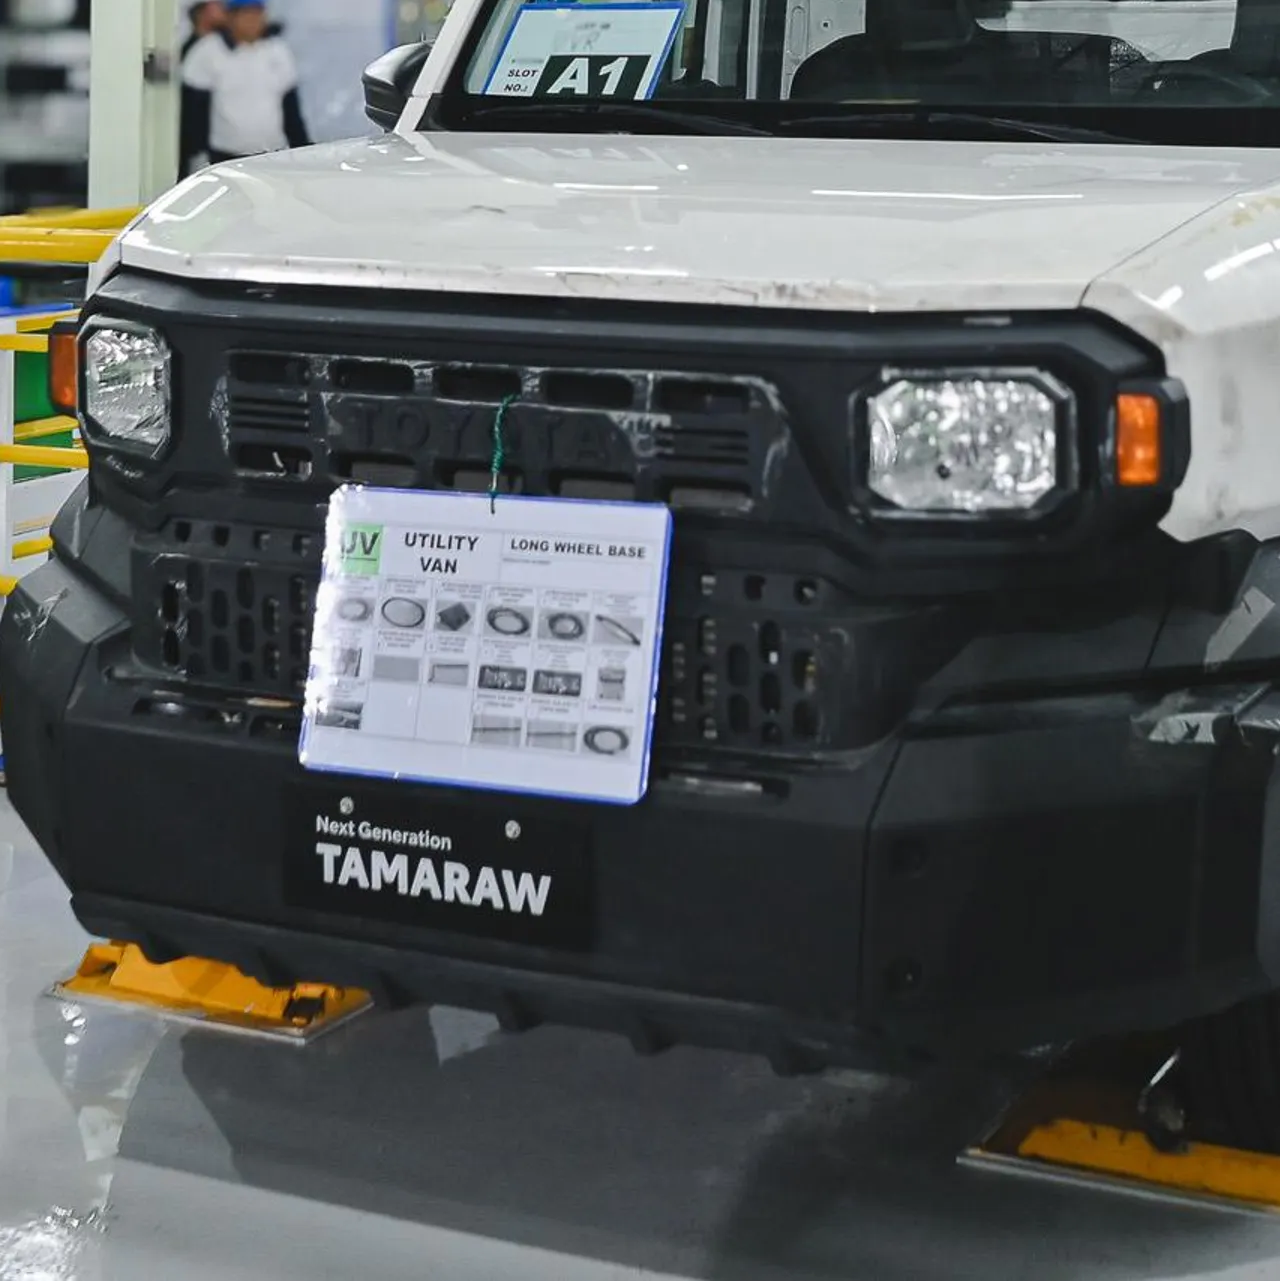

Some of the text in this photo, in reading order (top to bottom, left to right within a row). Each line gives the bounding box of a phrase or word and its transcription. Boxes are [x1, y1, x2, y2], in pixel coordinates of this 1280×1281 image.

[507, 69, 538, 78] SLOT
[547, 57, 629, 95] A1
[404, 531, 479, 551] UTILITY
[510, 538, 647, 559] LONG WHEEL BASE
[420, 556, 458, 574] VAN
[315, 815, 453, 851] Next Generation
[315, 841, 552, 916] TAMARAW
